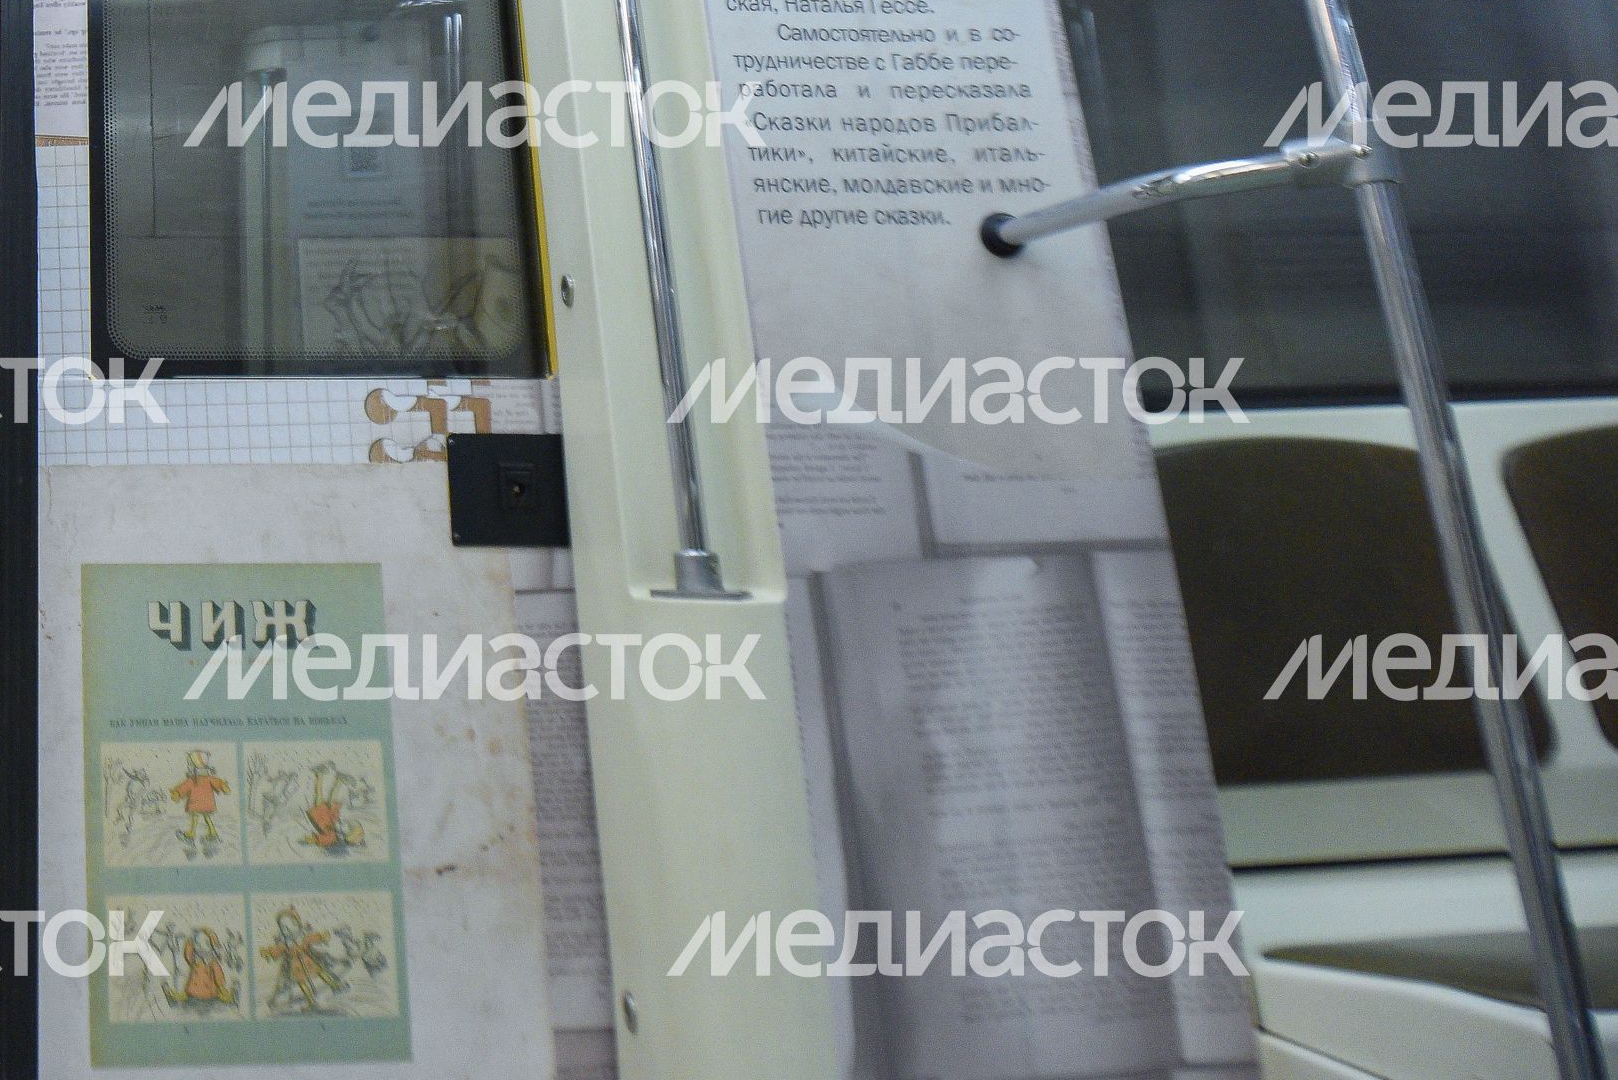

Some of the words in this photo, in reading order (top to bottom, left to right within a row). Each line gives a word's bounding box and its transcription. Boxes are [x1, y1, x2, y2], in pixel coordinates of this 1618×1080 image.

[778, 22, 935, 43] Самостоятельно
[947, 28, 958, 41] и
[971, 27, 981, 41] в
[992, 27, 1020, 41] со-
[734, 53, 868, 71] трудничестве
[876, 57, 886, 70] с
[891, 52, 954, 70] Габбе
[960, 55, 1018, 73] пере-
[738, 80, 837, 100] работала
[859, 83, 871, 98] и
[891, 82, 1030, 102] пересказала
[746, 109, 831, 131] «Сказки
[842, 115, 935, 134] народов
[946, 111, 1038, 134] Прибал-
[748, 145, 813, 164] тики»,
[832, 141, 955, 165] китайские,
[975, 146, 1045, 162] италь-
[754, 177, 836, 195] янские,
[844, 177, 973, 195] молдавские
[980, 177, 992, 193] и
[999, 177, 1050, 193] мно-
[758, 207, 792, 224] гие
[799, 207, 867, 228] другие
[875, 209, 950, 227] сказки.
[148, 600, 317, 651] ЧИЖ
